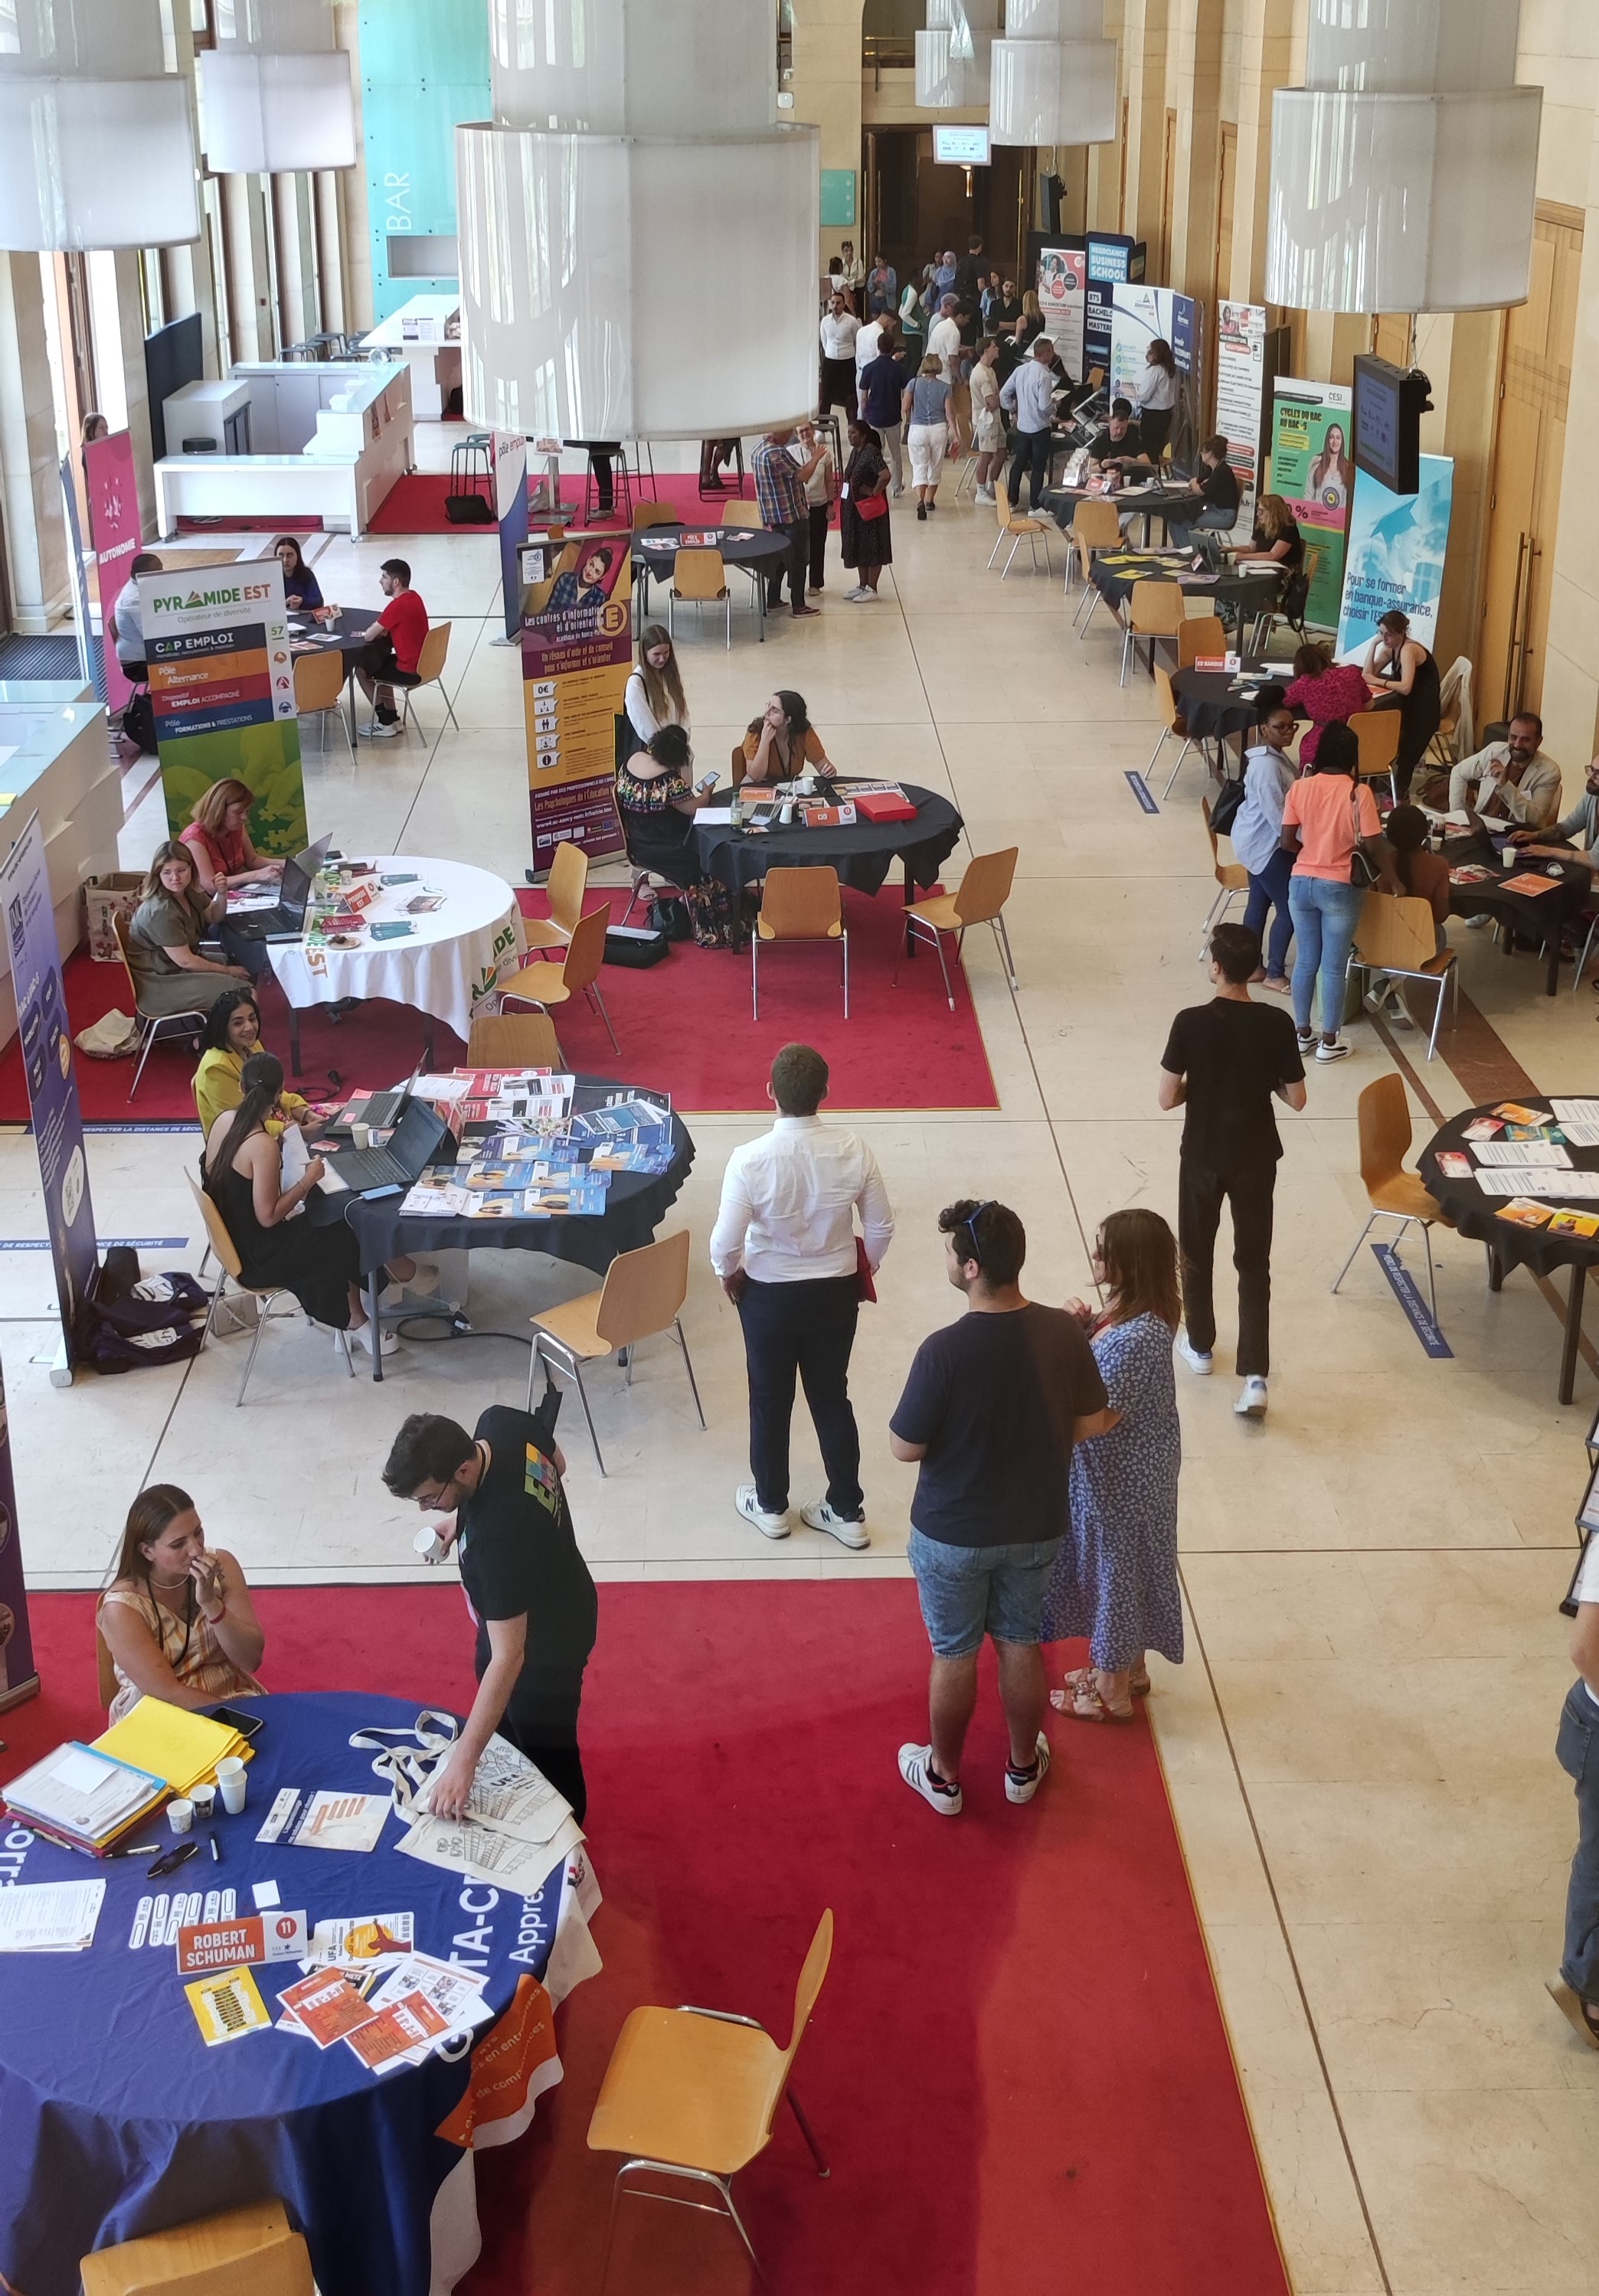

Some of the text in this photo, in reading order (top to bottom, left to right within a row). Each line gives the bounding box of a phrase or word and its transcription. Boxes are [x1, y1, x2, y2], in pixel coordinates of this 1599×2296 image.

[384, 171, 412, 230] BAR
[1091, 247, 1126, 258] NEGOCIANCE
[1091, 255, 1126, 268] BUSINESS
[1091, 266, 1126, 281] SCHOOL
[1089, 293, 1100, 302] BTS
[1329, 392, 1342, 401] CESI
[1280, 407, 1322, 422] CYCLES DU BAC
[1280, 418, 1287, 428] AU
[1287, 420, 1300, 429] BAC
[499, 443, 509, 460] pôle
[99, 537, 136, 565] AUTONOMIE
[1346, 572, 1406, 595] Pour se former
[244, 583, 271, 601] EST
[1346, 590, 1433, 619] en banque-assurance,
[178, 613, 212, 624] Opérateur
[224, 606, 252, 617] diversité
[525, 616, 535, 627] Les
[536, 612, 561, 625] centres
[606, 607, 619, 629] E
[1342, 606, 1369, 621] choisir
[271, 625, 284, 635] 57
[556, 622, 563, 633] et
[185, 632, 234, 650] EMPLOI
[549, 650, 566, 661] réseau
[567, 647, 581, 658] d'aide
[588, 645, 594, 654] de
[595, 642, 613, 652] conseil
[159, 665, 176, 676] Pôle
[544, 663, 555, 674] pour
[556, 659, 581, 671] s'informer
[588, 653, 612, 665] s'orienter
[168, 671, 209, 684] Alternance
[162, 691, 190, 702] Dispositif
[538, 685, 549, 694] 0€
[171, 690, 240, 708] EMPLOI ACCOMPAGNÉ
[165, 719, 181, 728] Pôle
[175, 721, 211, 734] FORMATIONS
[216, 714, 253, 727] PRESTATIONS
[535, 801, 544, 812] Les
[544, 795, 577, 809] Psychologues
[577, 793, 584, 802] de
[125, 1239, 164, 1247] SÉCURITÉ
[1392, 1272, 1411, 1294] RESPECTER
[1406, 1299, 1424, 1320] DISTANCE
[1421, 1325, 1442, 1346] SÉCURITÉ
[280, 1920, 293, 1934] 11
[508, 1883, 548, 1965] Appre
[193, 1928, 247, 1950] ROBERT
[186, 1944, 255, 1968] SCHUMAN
[327, 1944, 337, 1962] UFA
[484, 2049, 501, 2063] en
